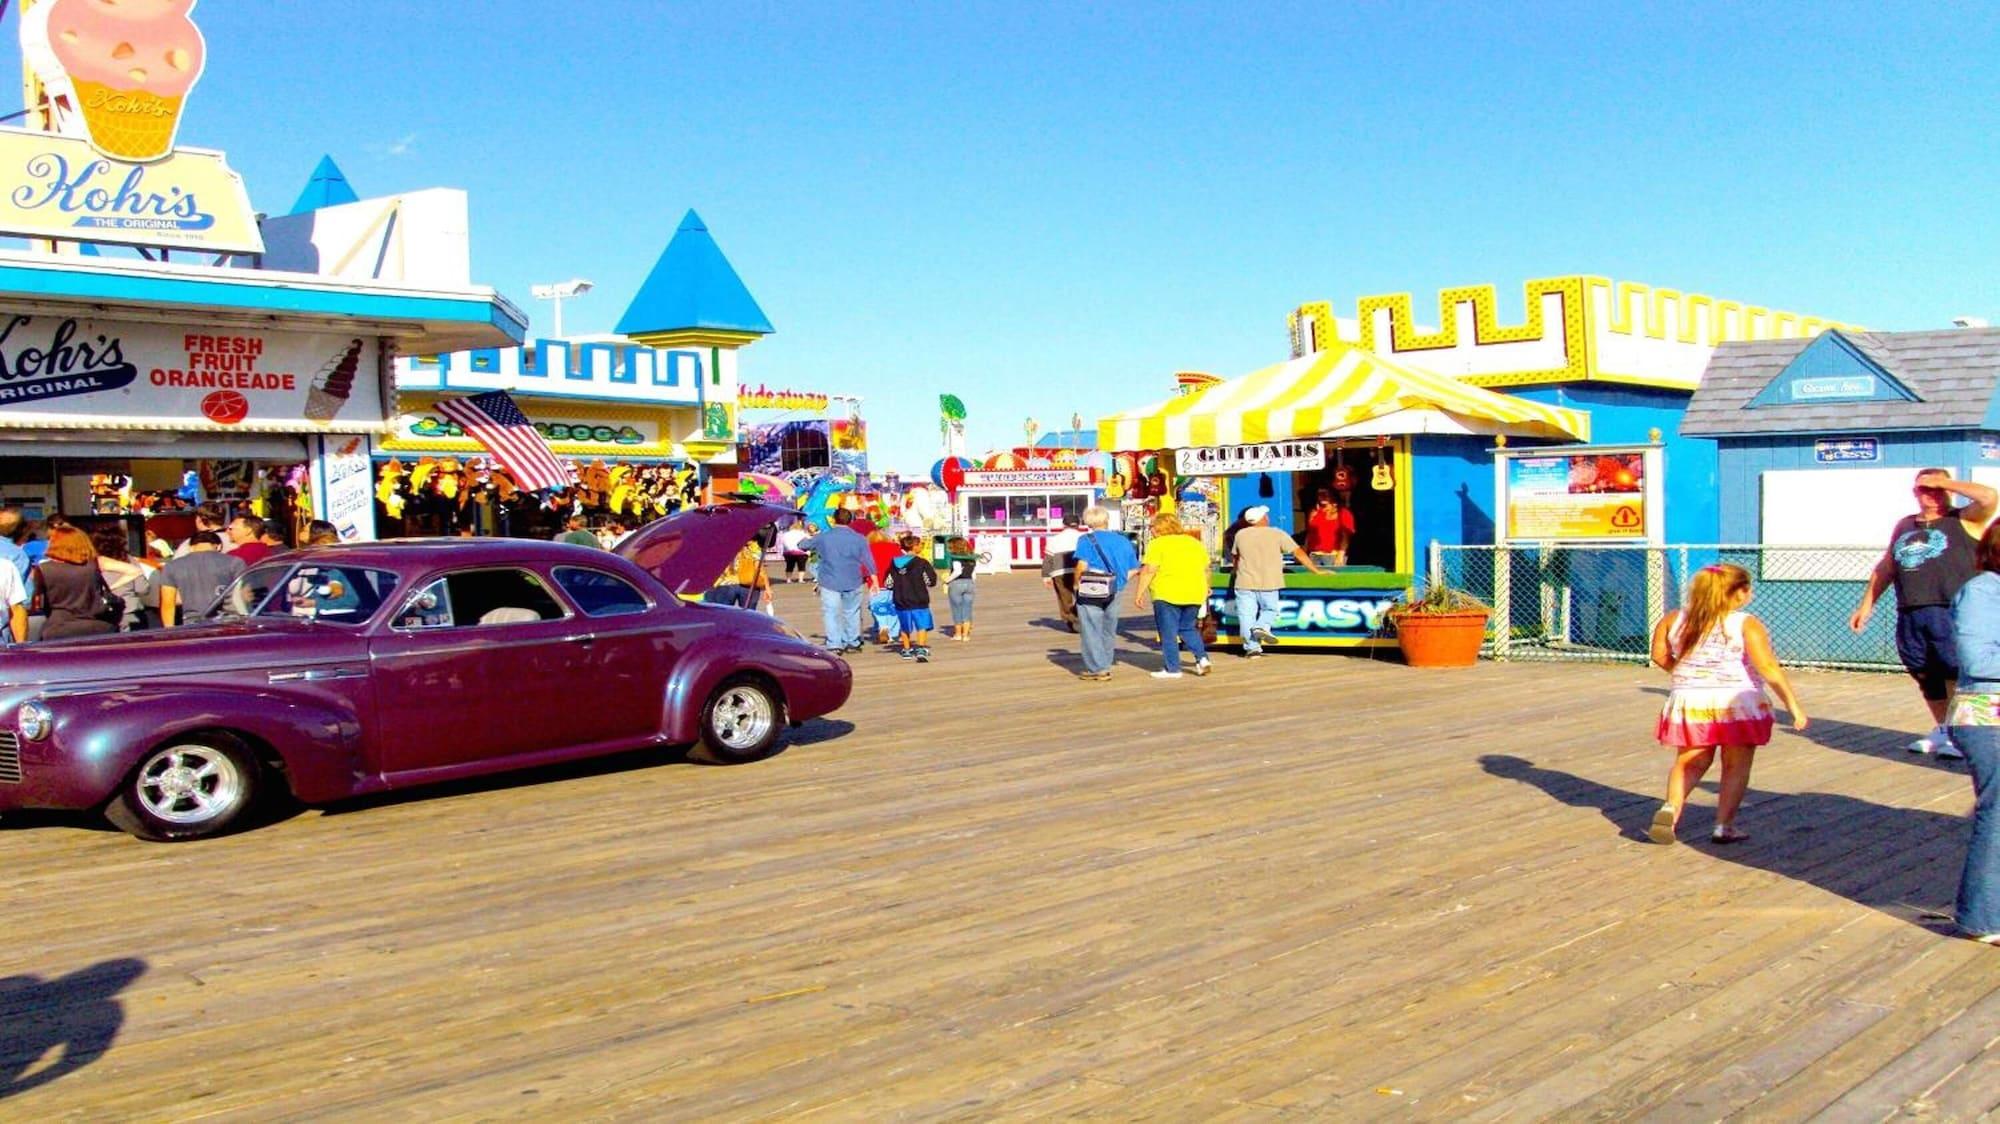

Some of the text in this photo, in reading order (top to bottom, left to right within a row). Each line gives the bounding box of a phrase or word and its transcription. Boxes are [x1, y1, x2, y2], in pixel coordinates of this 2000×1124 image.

[12, 153, 197, 218] Kohr's
[94, 217, 180, 230] THE ORIGINAL
[183, 334, 263, 354] FRESH
[189, 352, 257, 372] FRUIT
[150, 368, 296, 390] ORANGEADE
[1196, 442, 1319, 462] GUITARS
[1273, 597, 1393, 630] EASY
